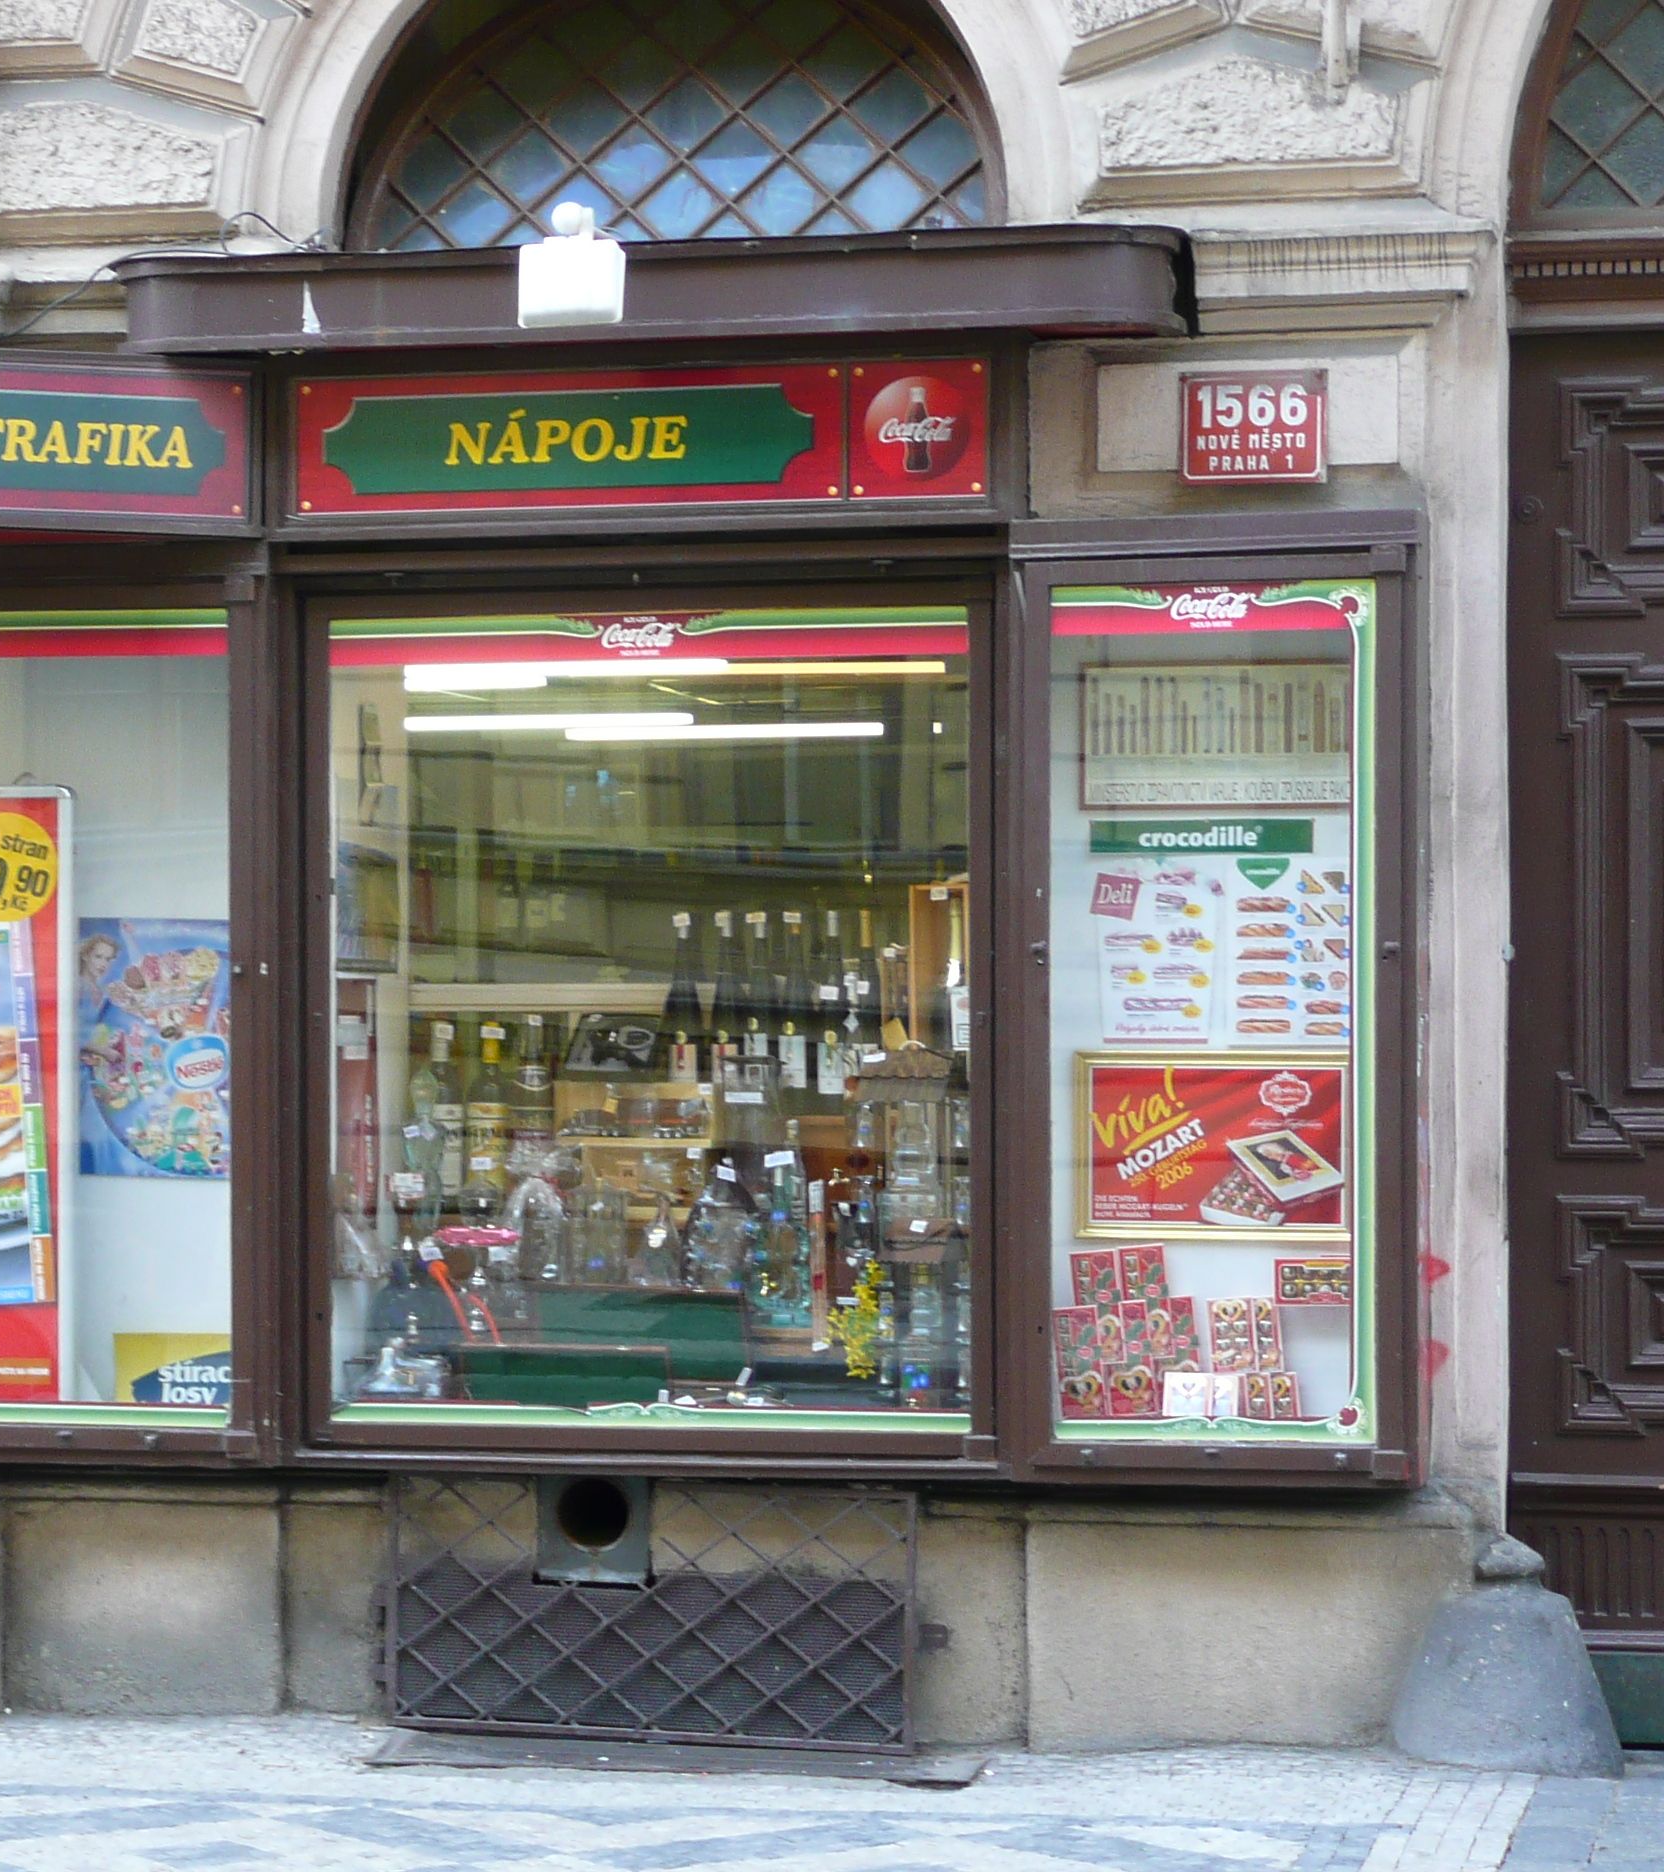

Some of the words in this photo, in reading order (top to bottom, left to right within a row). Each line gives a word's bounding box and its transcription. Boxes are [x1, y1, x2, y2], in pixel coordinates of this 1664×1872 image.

[1196, 383, 1308, 429] 1566
[444, 409, 688, 466] NÁPOJE
[1196, 430, 1240, 451] NOVÉ
[1248, 428, 1306, 450] MĚSTO
[1208, 455, 1270, 472] PRAHA
[1285, 453, 1294, 470] 1
[0, 833, 50, 861] stran
[1097, 882, 1134, 906] Deli
[1116, 1117, 1206, 1181] MOZART
[1148, 1138, 1209, 1177] GEBURTSTAG
[1155, 1160, 1194, 1191] 2006
[157, 1359, 232, 1384] stírac
[161, 1382, 218, 1405] losy
